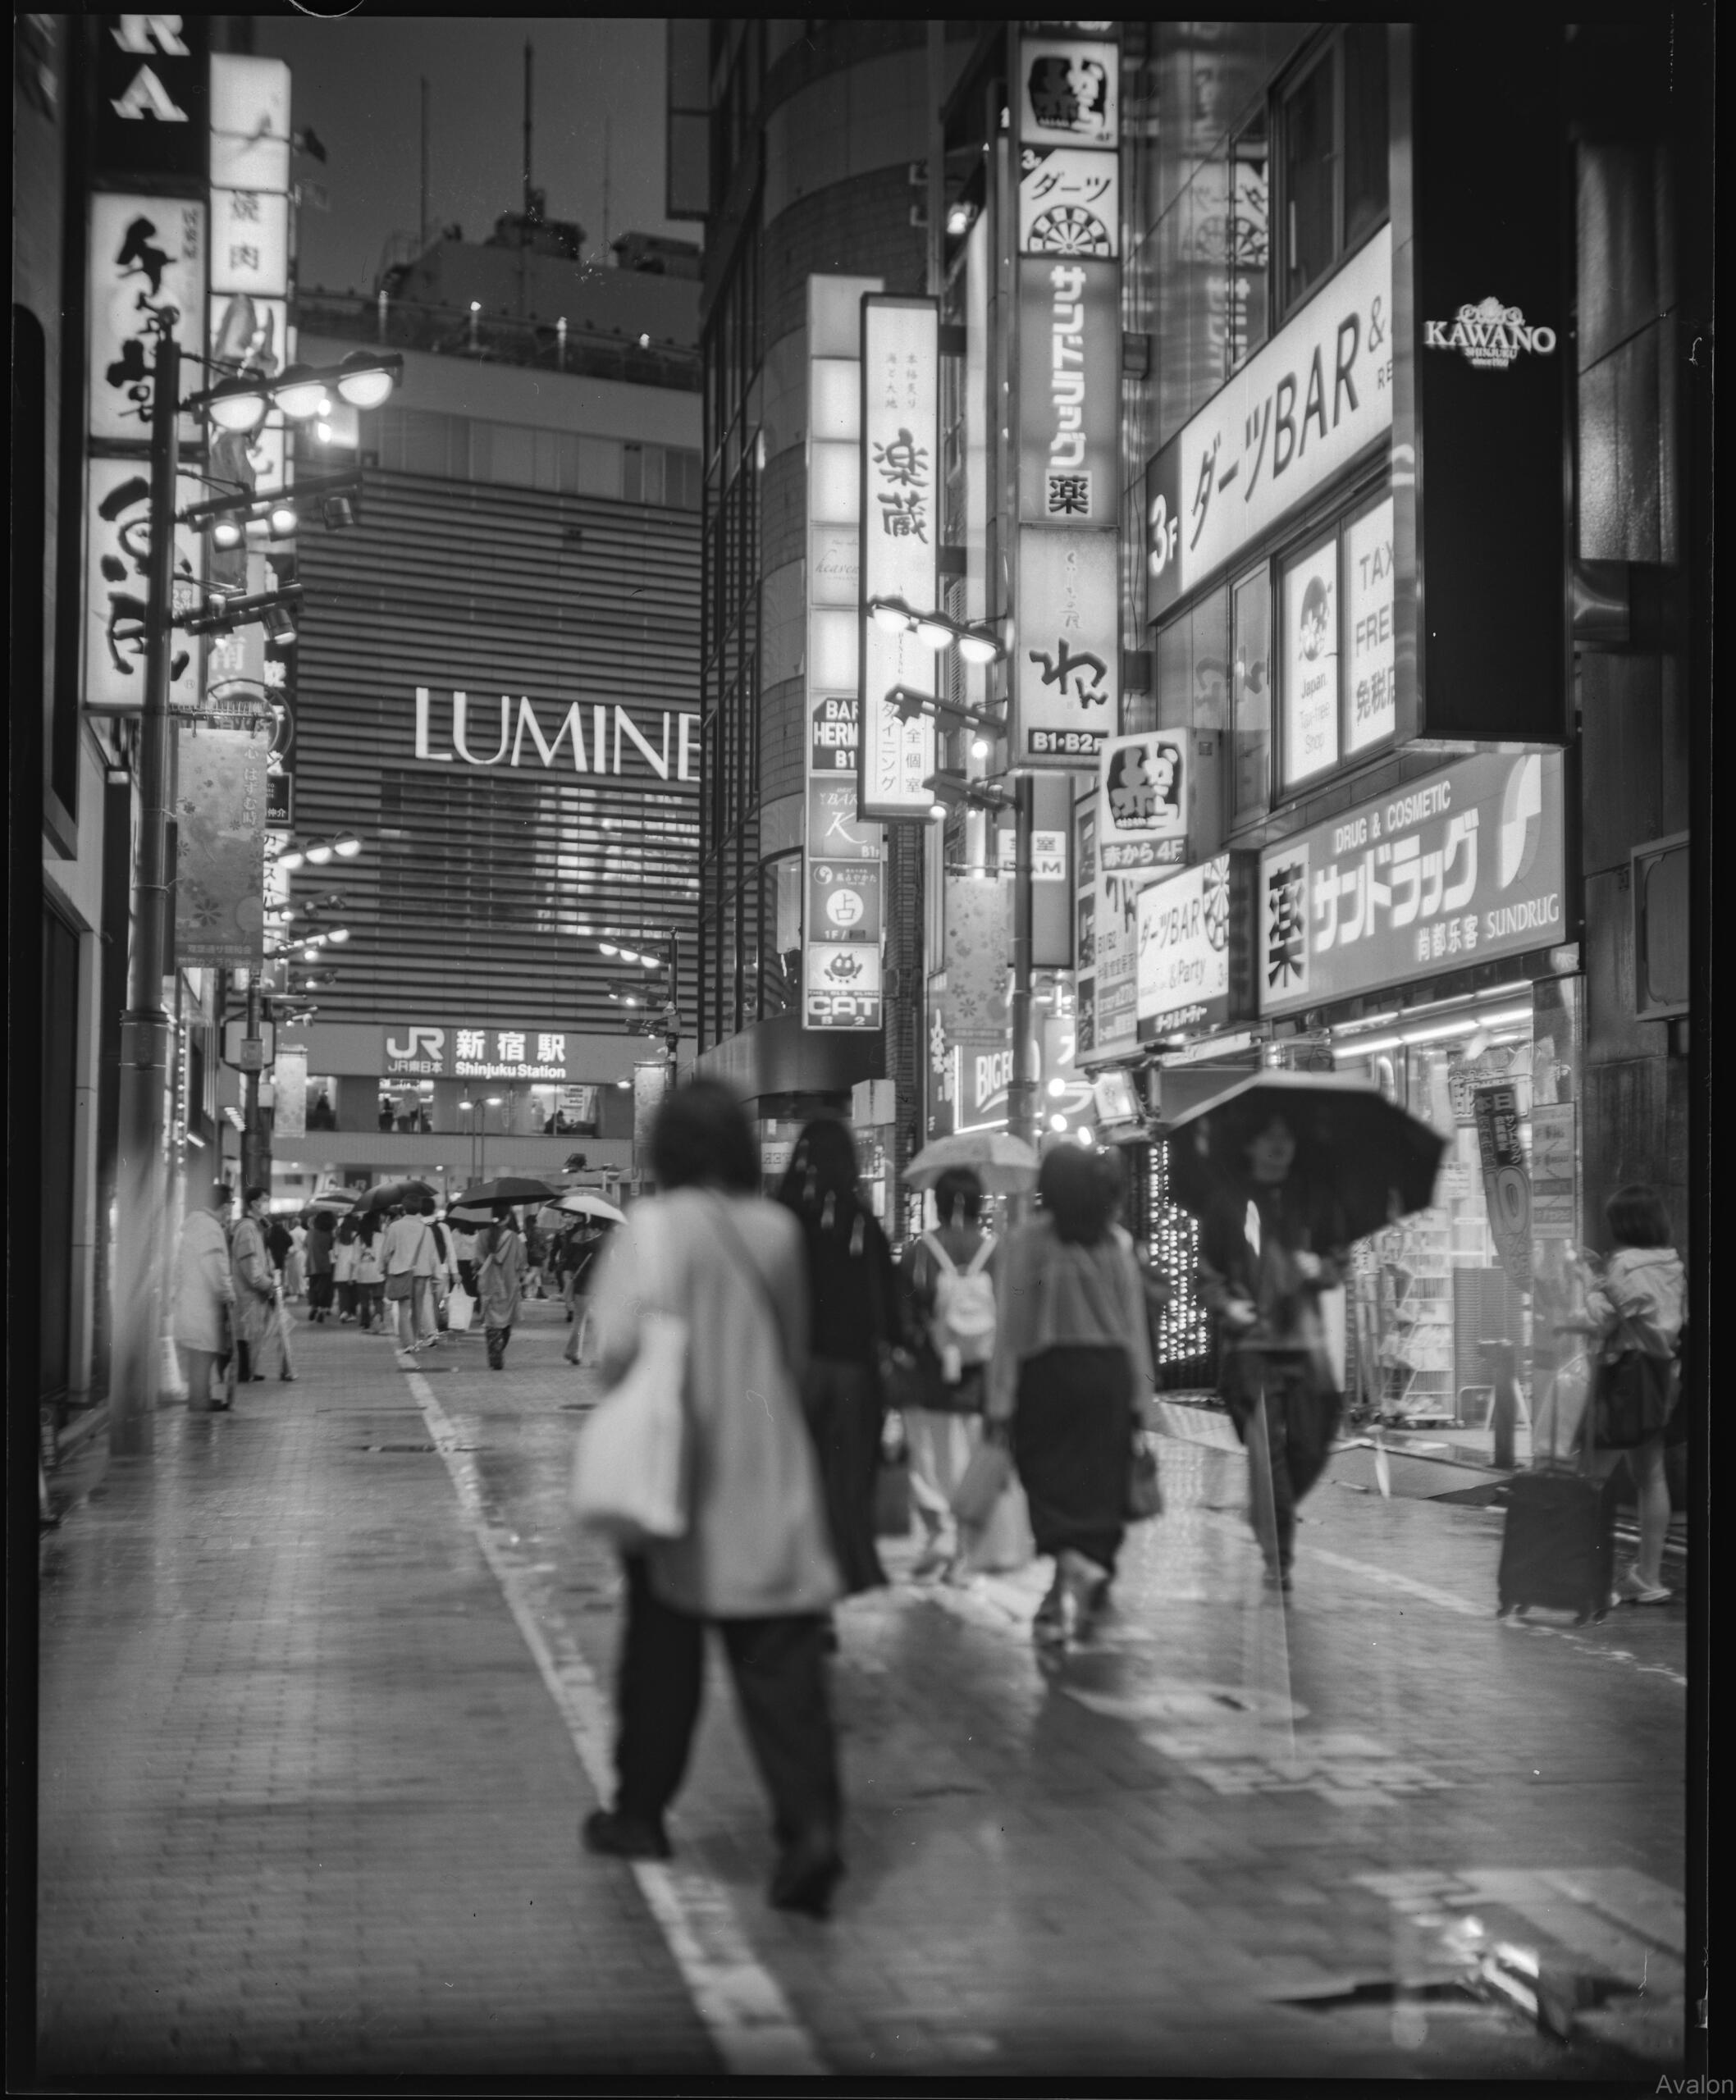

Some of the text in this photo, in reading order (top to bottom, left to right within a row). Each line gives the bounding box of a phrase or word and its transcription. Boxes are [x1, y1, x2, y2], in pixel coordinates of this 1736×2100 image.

[1032, 172, 1111, 202] ダーツ
[1424, 321, 1556, 354] KAWANO
[1050, 265, 1085, 467] サンドラッグ
[872, 427, 930, 545] 楽蔵
[1048, 474, 1089, 514] 薬
[1356, 601, 1394, 657] FRE
[415, 687, 701, 782] LUMINE
[906, 727, 921, 792] 全個室
[1335, 780, 1452, 856] DRUG & COSMETIC
[1103, 838, 1185, 871] 赤から 4F
[1313, 807, 1480, 953] サンドラッグ
[835, 892, 856, 921] 占
[1268, 861, 1306, 989] 薬
[1487, 893, 1560, 939] SUNDRUG
[808, 996, 879, 1016] CAT
[386, 1026, 445, 1060] JR
[455, 1029, 566, 1062] 新宿駅
[388, 1060, 443, 1073] JR東日本
[455, 1061, 566, 1080] Shinjuku Station
